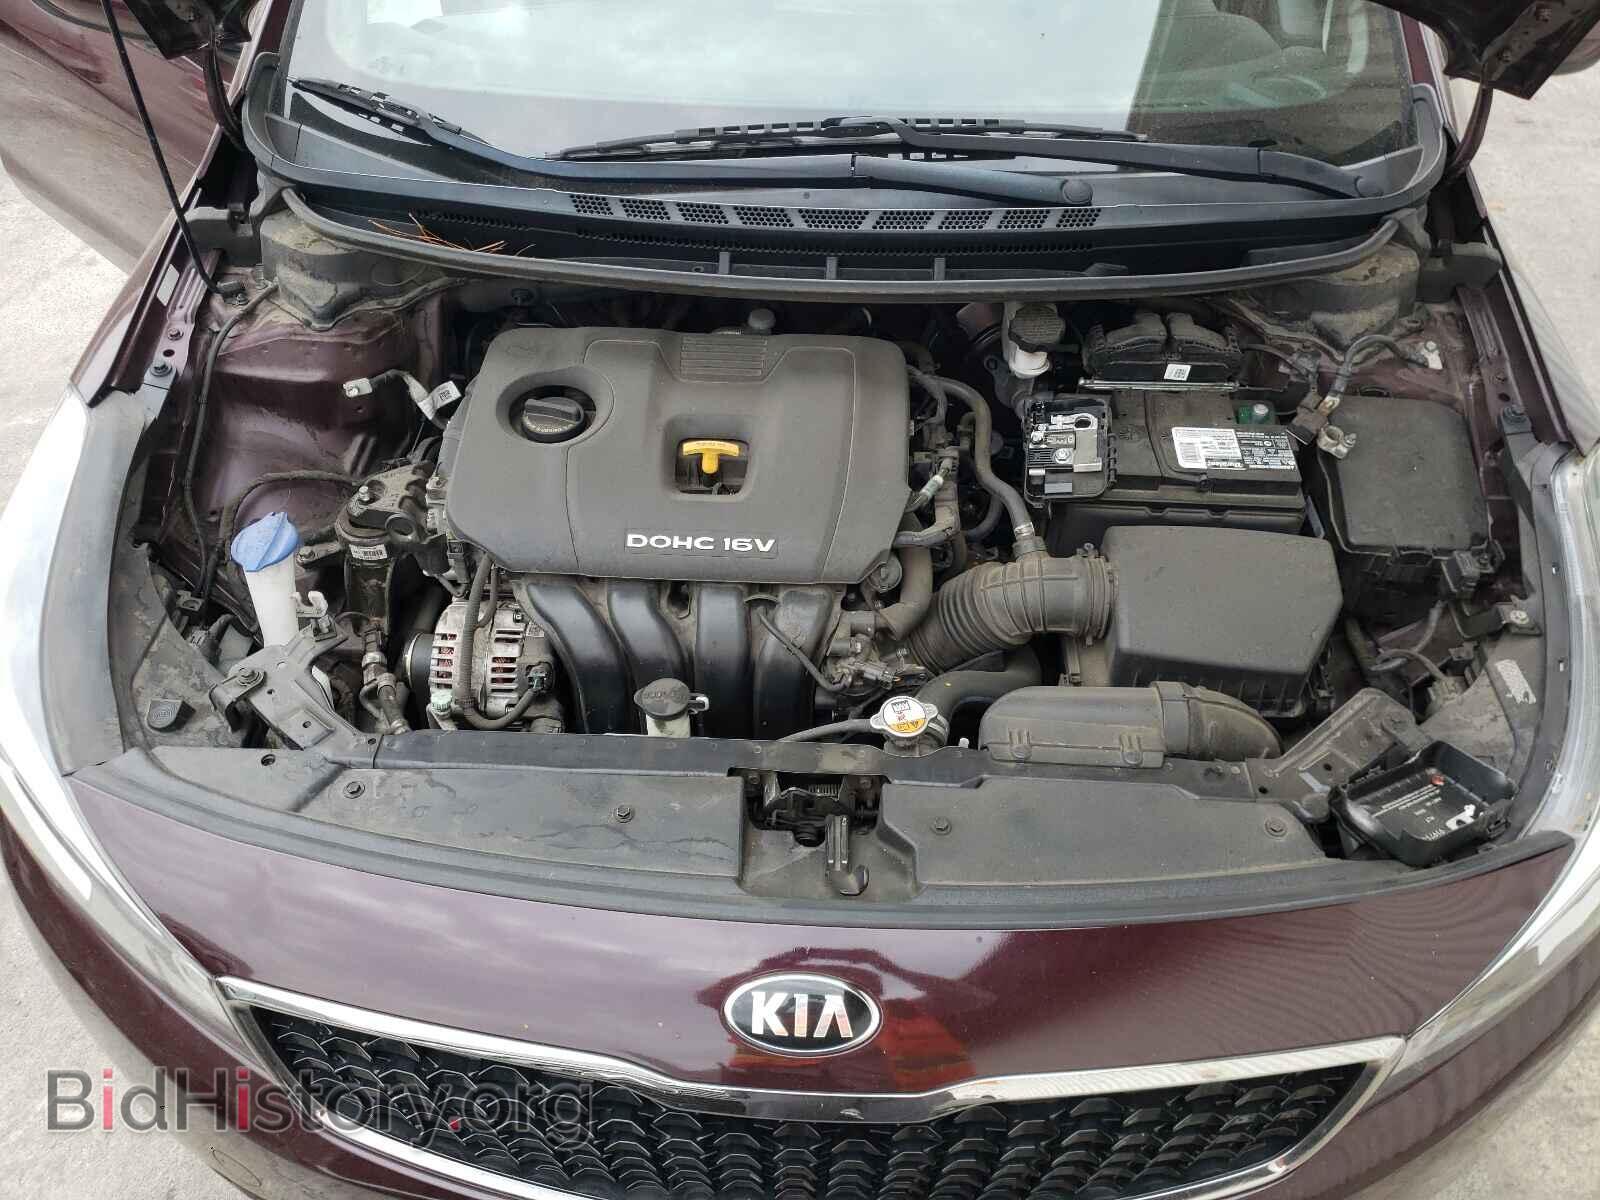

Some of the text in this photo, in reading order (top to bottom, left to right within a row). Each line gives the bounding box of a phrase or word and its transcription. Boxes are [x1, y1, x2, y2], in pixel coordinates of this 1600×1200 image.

[626, 533, 776, 552] DOHC 16V
[751, 991, 854, 1038] KIA
